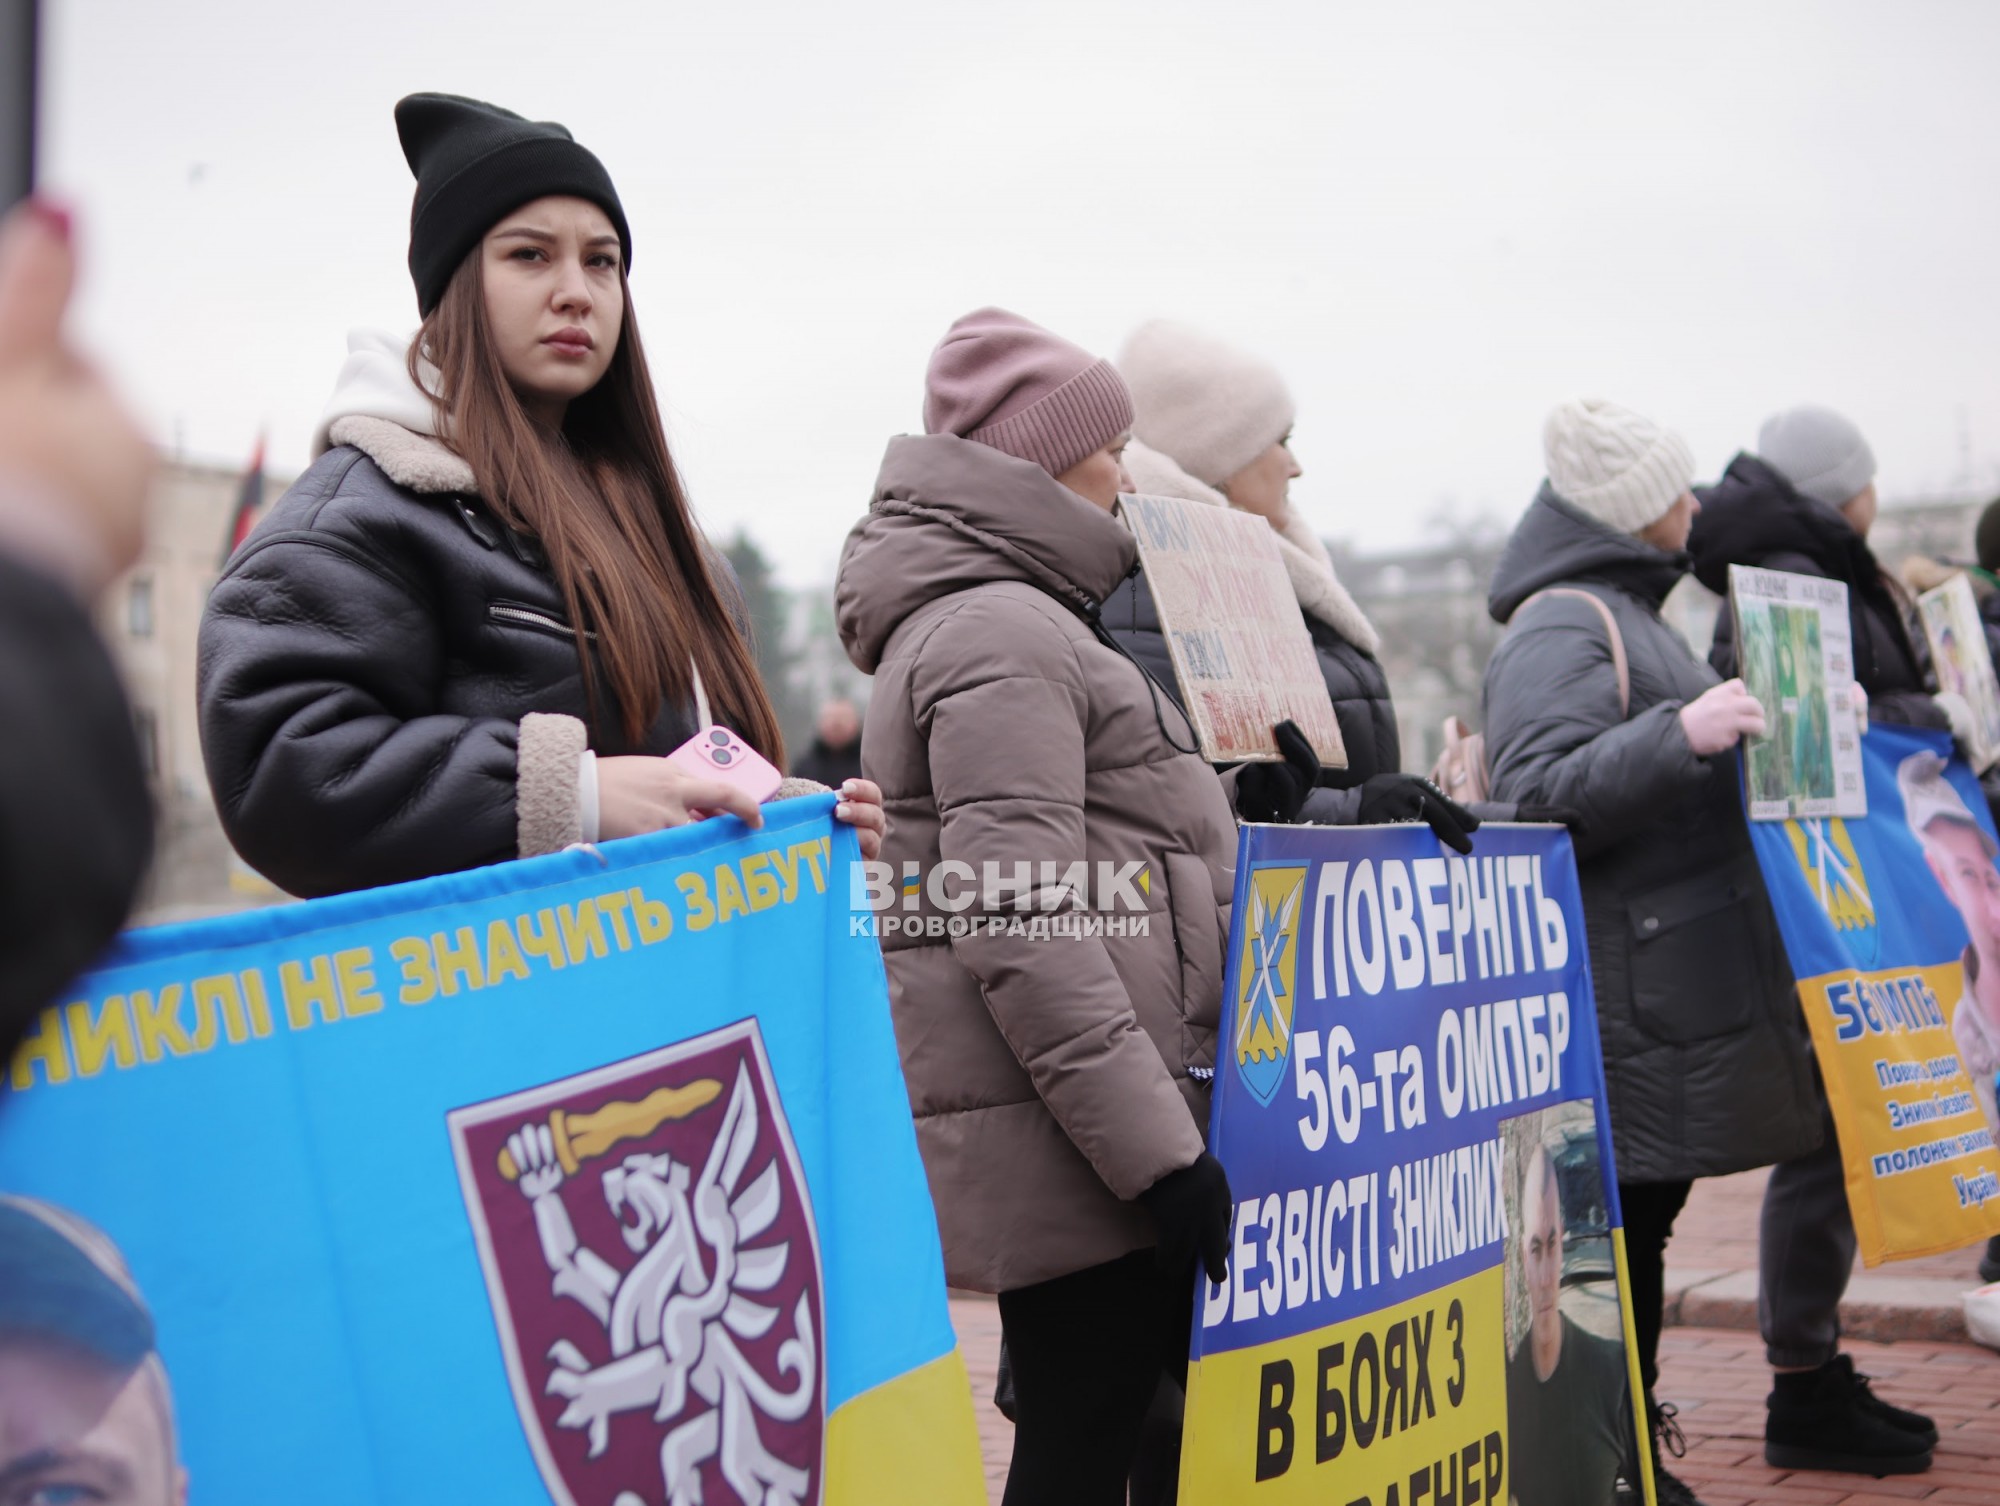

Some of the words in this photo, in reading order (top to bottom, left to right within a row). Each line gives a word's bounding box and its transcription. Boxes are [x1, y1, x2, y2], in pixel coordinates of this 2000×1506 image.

[1, 968, 273, 1092] НИКЛІ
[279, 946, 386, 1032] НЕ
[398, 885, 674, 1006] ЗНАЧИТЬ
[1312, 854, 1570, 1000] ПОВЕРНІТЬ
[1295, 1024, 1428, 1152] 56-та
[1437, 991, 1571, 1120] ОМПБР
[1387, 1137, 1509, 1279] ЗНИКЛИХ
[1255, 1358, 1296, 1484] В
[1315, 1308, 1437, 1466] БОЯХ
